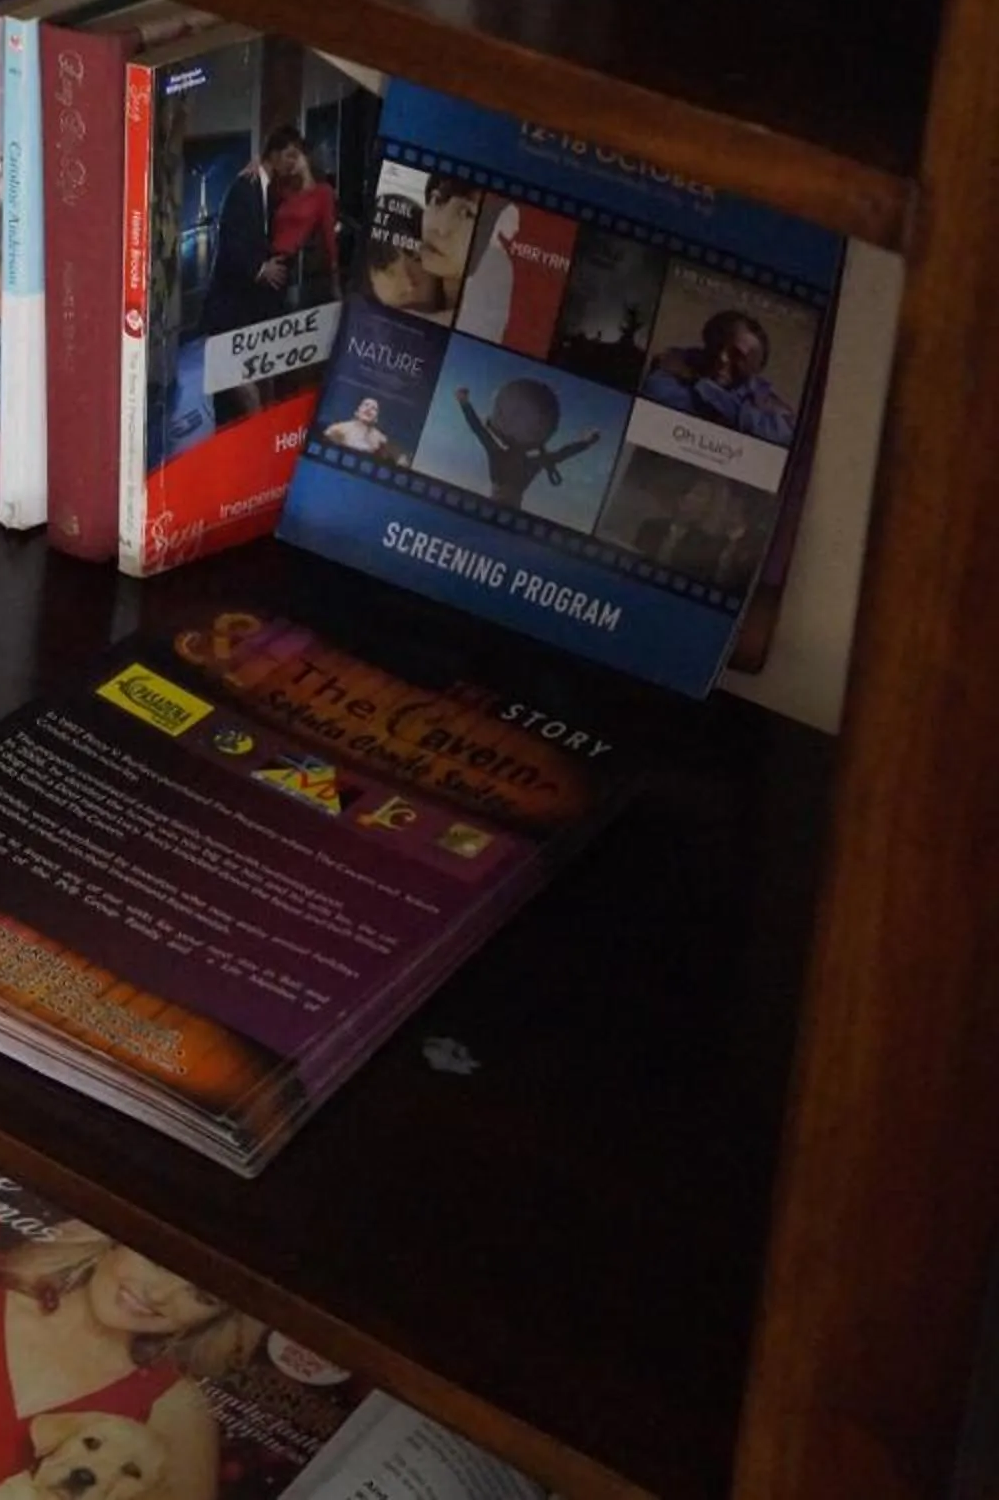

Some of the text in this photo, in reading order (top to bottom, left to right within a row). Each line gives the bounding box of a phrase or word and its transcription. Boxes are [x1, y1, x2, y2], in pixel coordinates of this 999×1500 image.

[130, 211, 142, 245] Helen
[371, 226, 392, 243] MY
[232, 309, 320, 355] BUNDLE
[347, 336, 425, 376] NATURE
[383, 521, 623, 632] SCREENING PROGRAM
[292, 662, 375, 721] The
[502, 702, 613, 758] STORY
